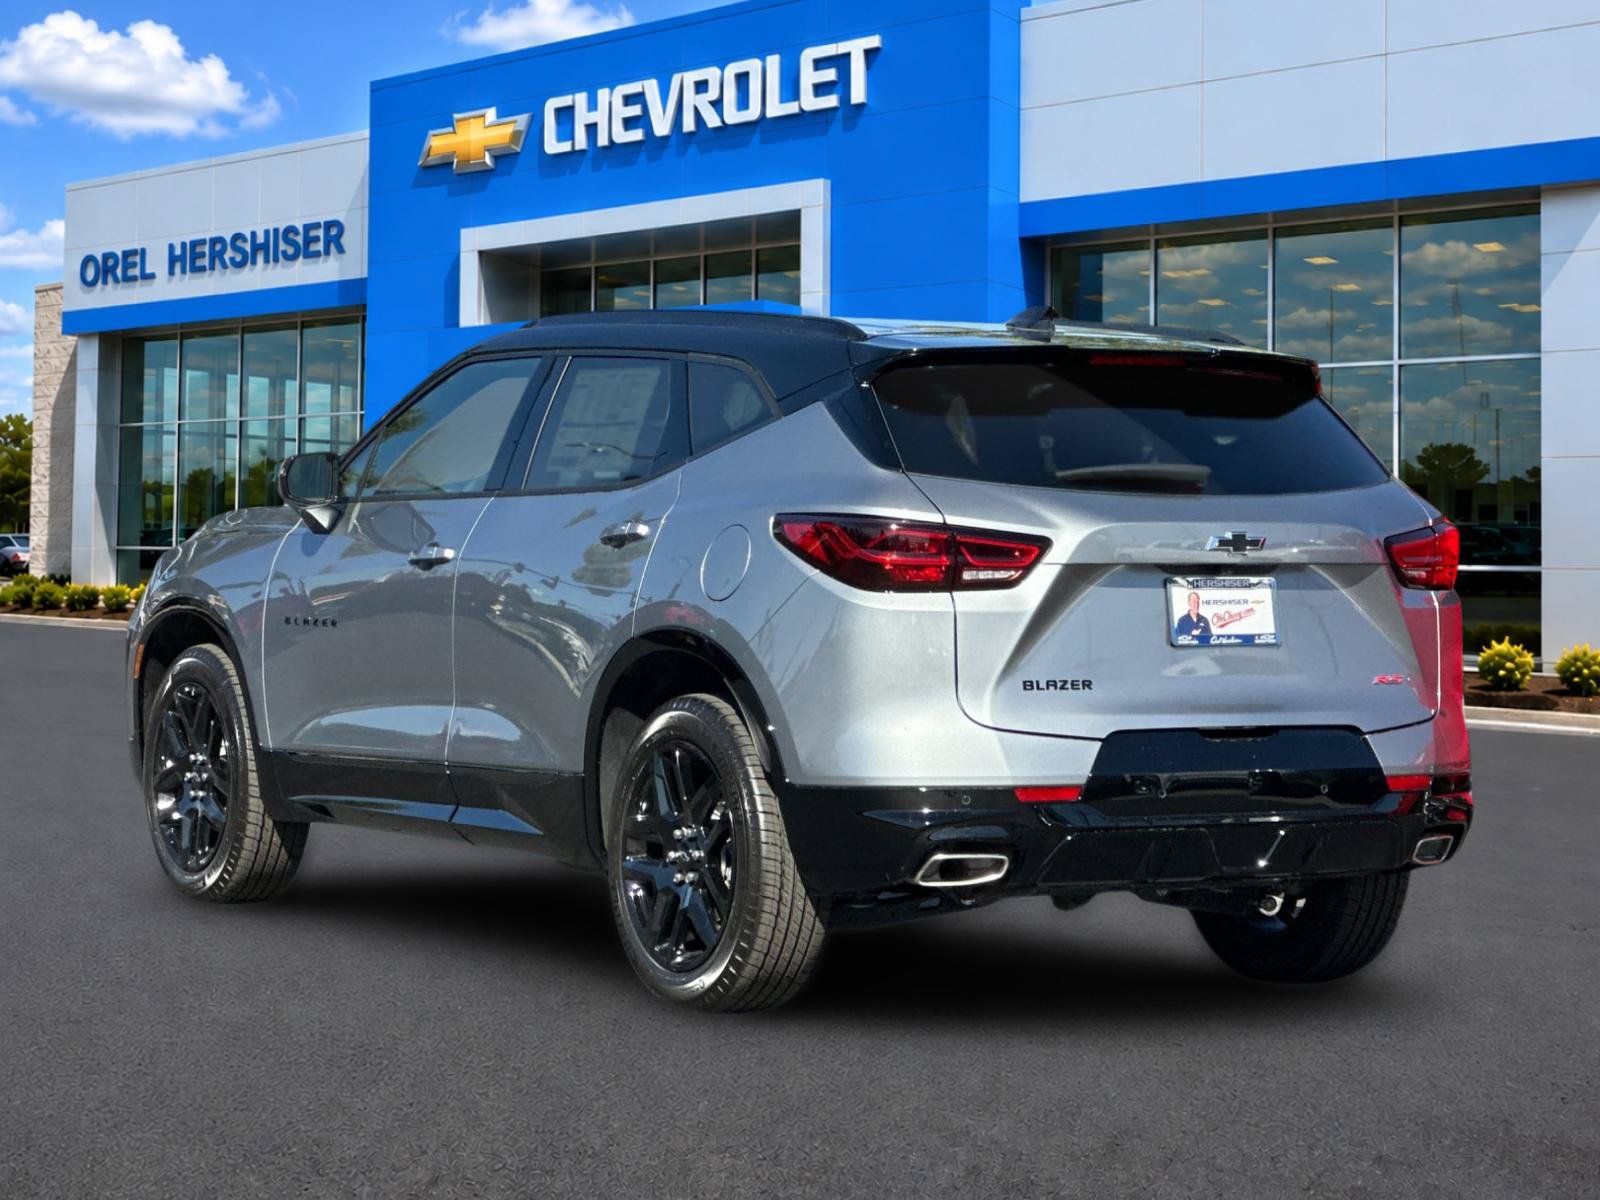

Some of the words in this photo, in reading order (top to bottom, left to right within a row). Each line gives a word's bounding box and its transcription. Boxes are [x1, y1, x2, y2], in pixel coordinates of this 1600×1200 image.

[544, 34, 882, 154] CHEVROLET
[79, 248, 156, 287] OREL
[167, 219, 346, 276] HERSHISER
[1193, 579, 1251, 588] HERSHISER
[284, 616, 338, 627] BLAZER
[1022, 679, 1093, 691] BLAZER
[1371, 673, 1404, 685] RS
